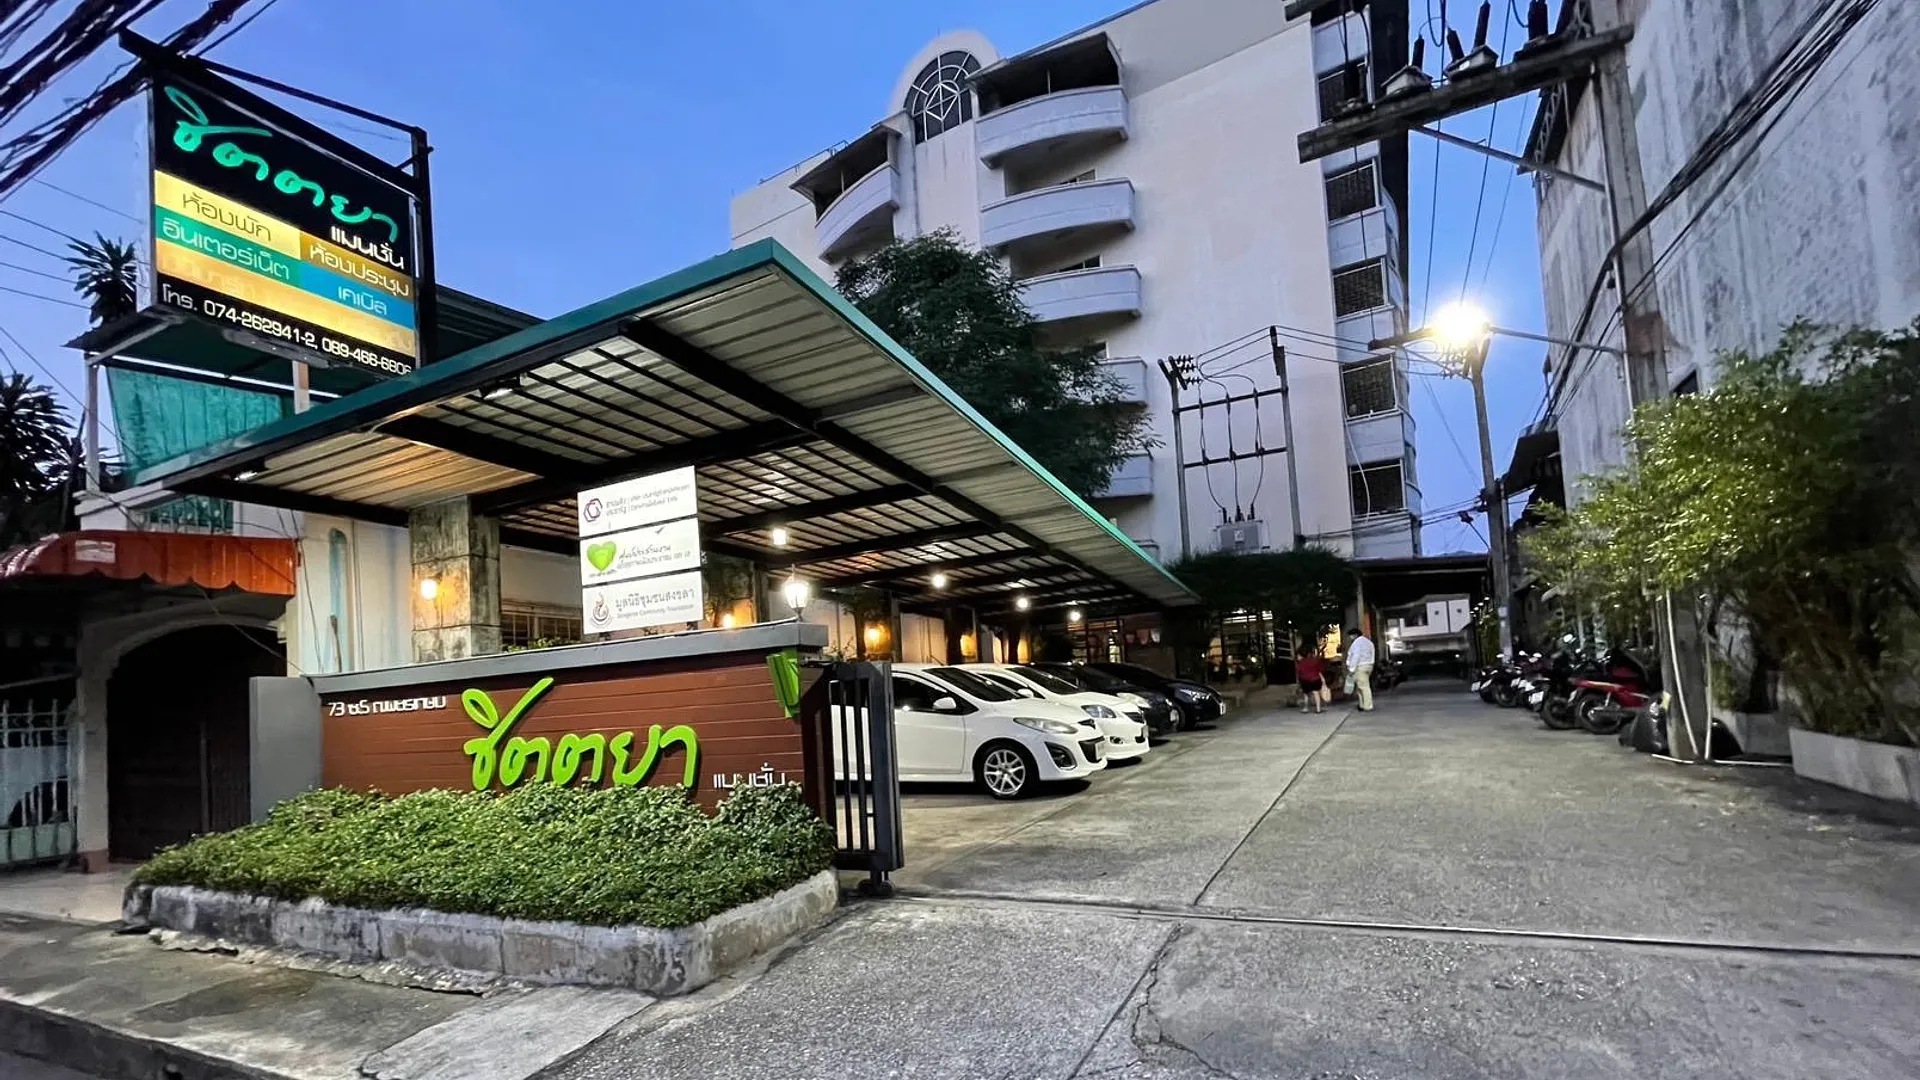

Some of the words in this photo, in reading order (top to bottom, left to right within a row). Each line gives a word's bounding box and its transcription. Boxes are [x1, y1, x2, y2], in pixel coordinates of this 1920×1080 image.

[182, 192, 271, 242] ห้องพัก
[162, 217, 289, 280] อินเตอร์เน็ต
[310, 242, 409, 297] ห้องประชุม
[331, 225, 405, 270] แมนชั่น
[162, 283, 198, 311] โทร.
[338, 286, 388, 315] เคเบิล
[328, 701, 345, 717] 73
